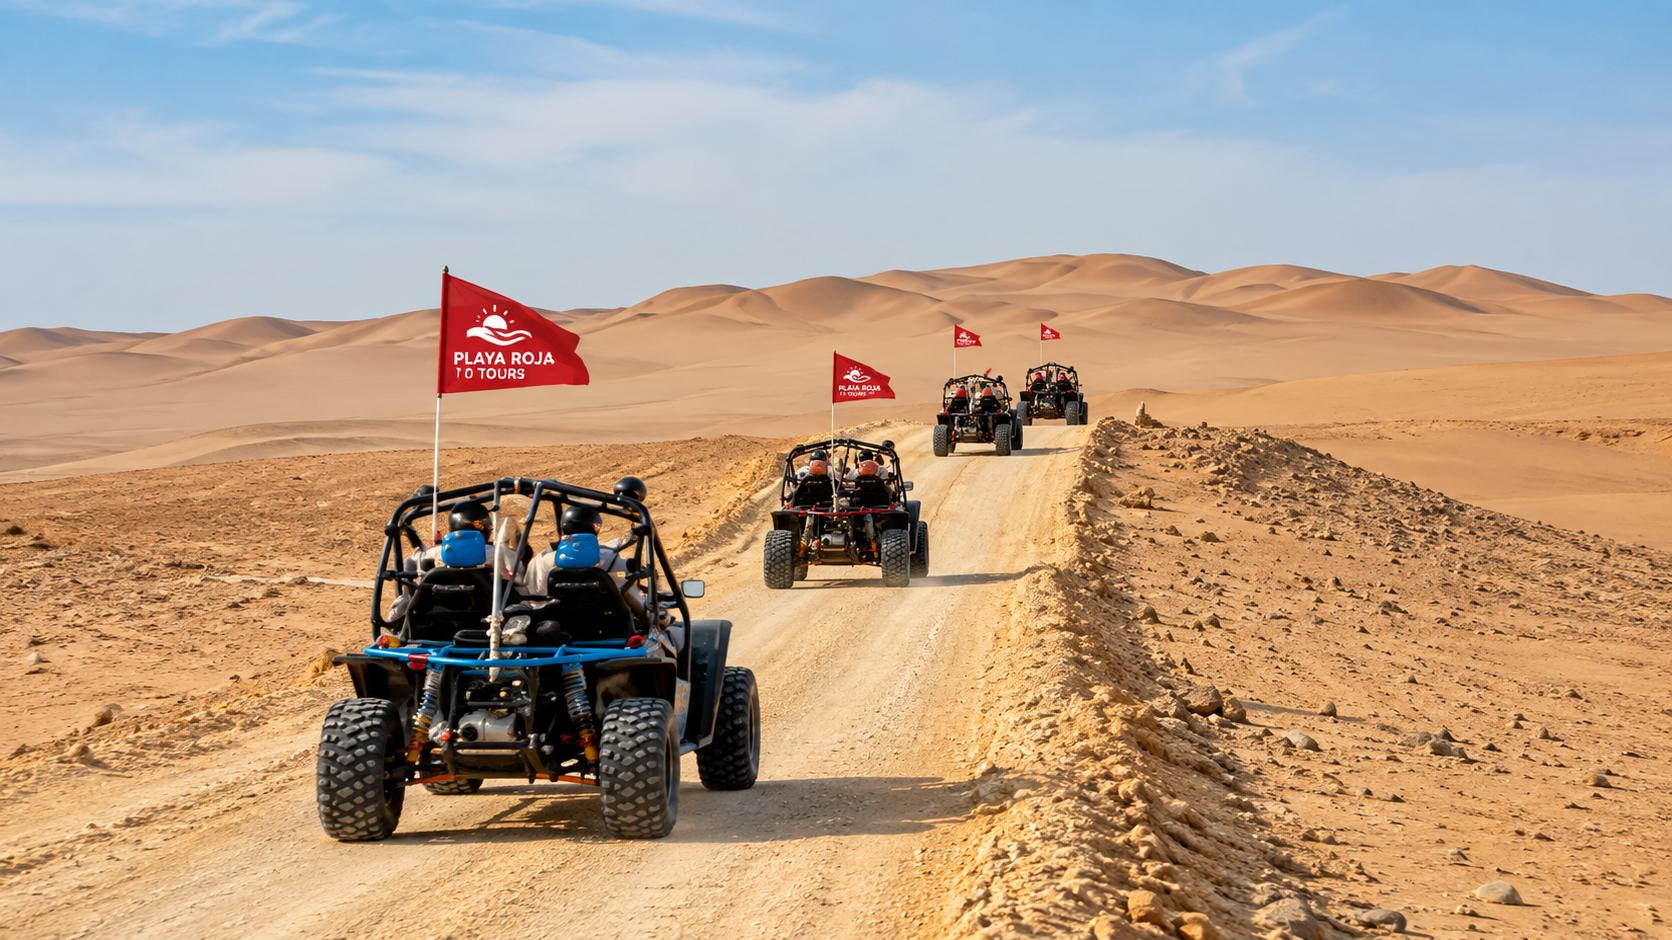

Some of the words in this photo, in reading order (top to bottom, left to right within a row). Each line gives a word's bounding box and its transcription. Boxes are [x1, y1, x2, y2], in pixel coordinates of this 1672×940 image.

[454, 351, 506, 366] PLAYA
[511, 351, 555, 366] ROJA
[477, 368, 525, 380] TOURS
